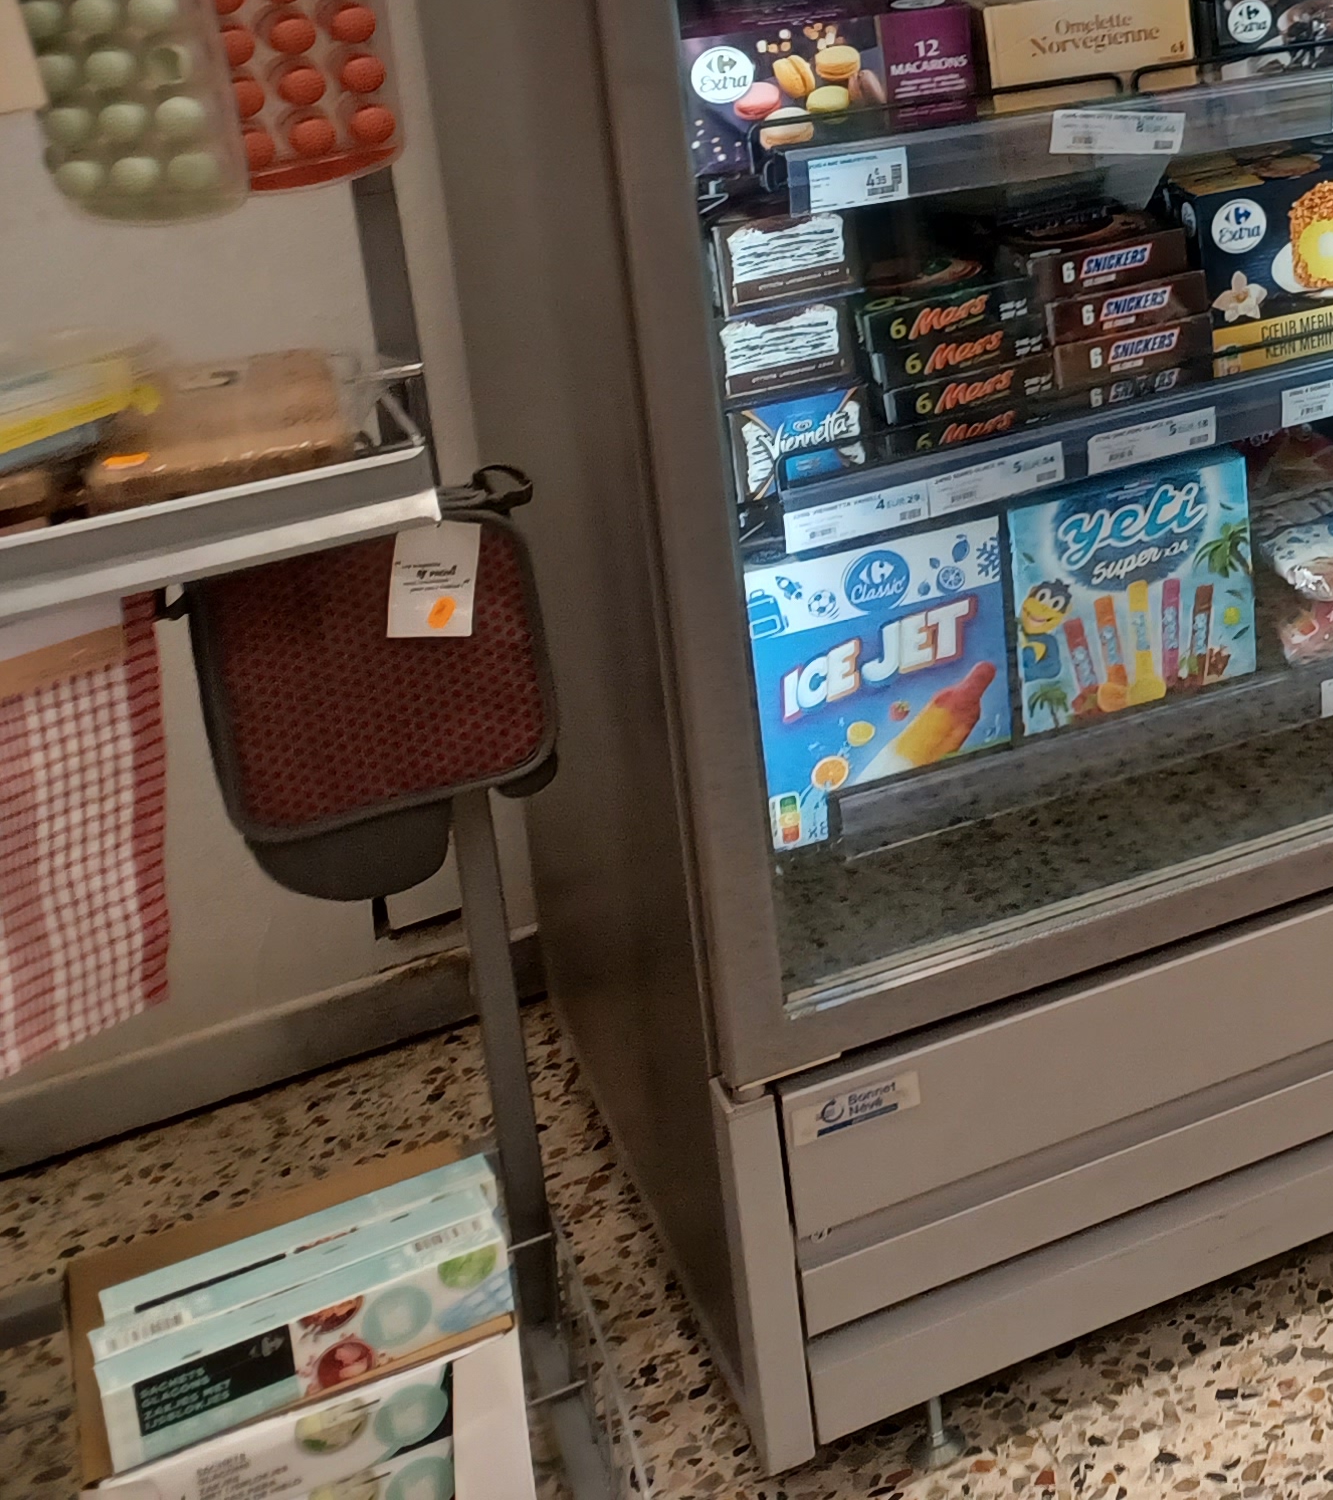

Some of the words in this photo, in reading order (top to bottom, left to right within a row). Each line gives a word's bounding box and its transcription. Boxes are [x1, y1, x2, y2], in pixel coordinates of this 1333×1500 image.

[1055, 13, 1132, 35] Omelette
[915, 39, 940, 58] 12
[890, 55, 969, 77] MACARONS
[700, 73, 749, 93] Extra
[1219, 223, 1262, 244] Extra
[1062, 261, 1076, 283] 6
[1085, 246, 1148, 274] SNICKERS
[890, 318, 907, 340] 6
[908, 293, 989, 340] Mars
[1081, 304, 1095, 326] 6
[1103, 288, 1168, 316] SNICKERS
[905, 352, 923, 374] 6
[923, 330, 1003, 374] Mars
[1089, 347, 1103, 369] 6
[1111, 332, 1175, 360] SNICKERS
[915, 391, 933, 413] 6
[934, 369, 1014, 414] Mars
[1090, 387, 1103, 407] 6
[760, 409, 848, 457] Viennetta
[1168, 424, 1177, 436] 5
[1012, 461, 1022, 474] 5
[875, 499, 886, 510] 4
[886, 497, 906, 510] EUR
[906, 493, 921, 504] 29
[1091, 547, 1163, 585] Super
[850, 574, 906, 605] Classic
[783, 638, 862, 721] ICE
[862, 599, 975, 683] JET
